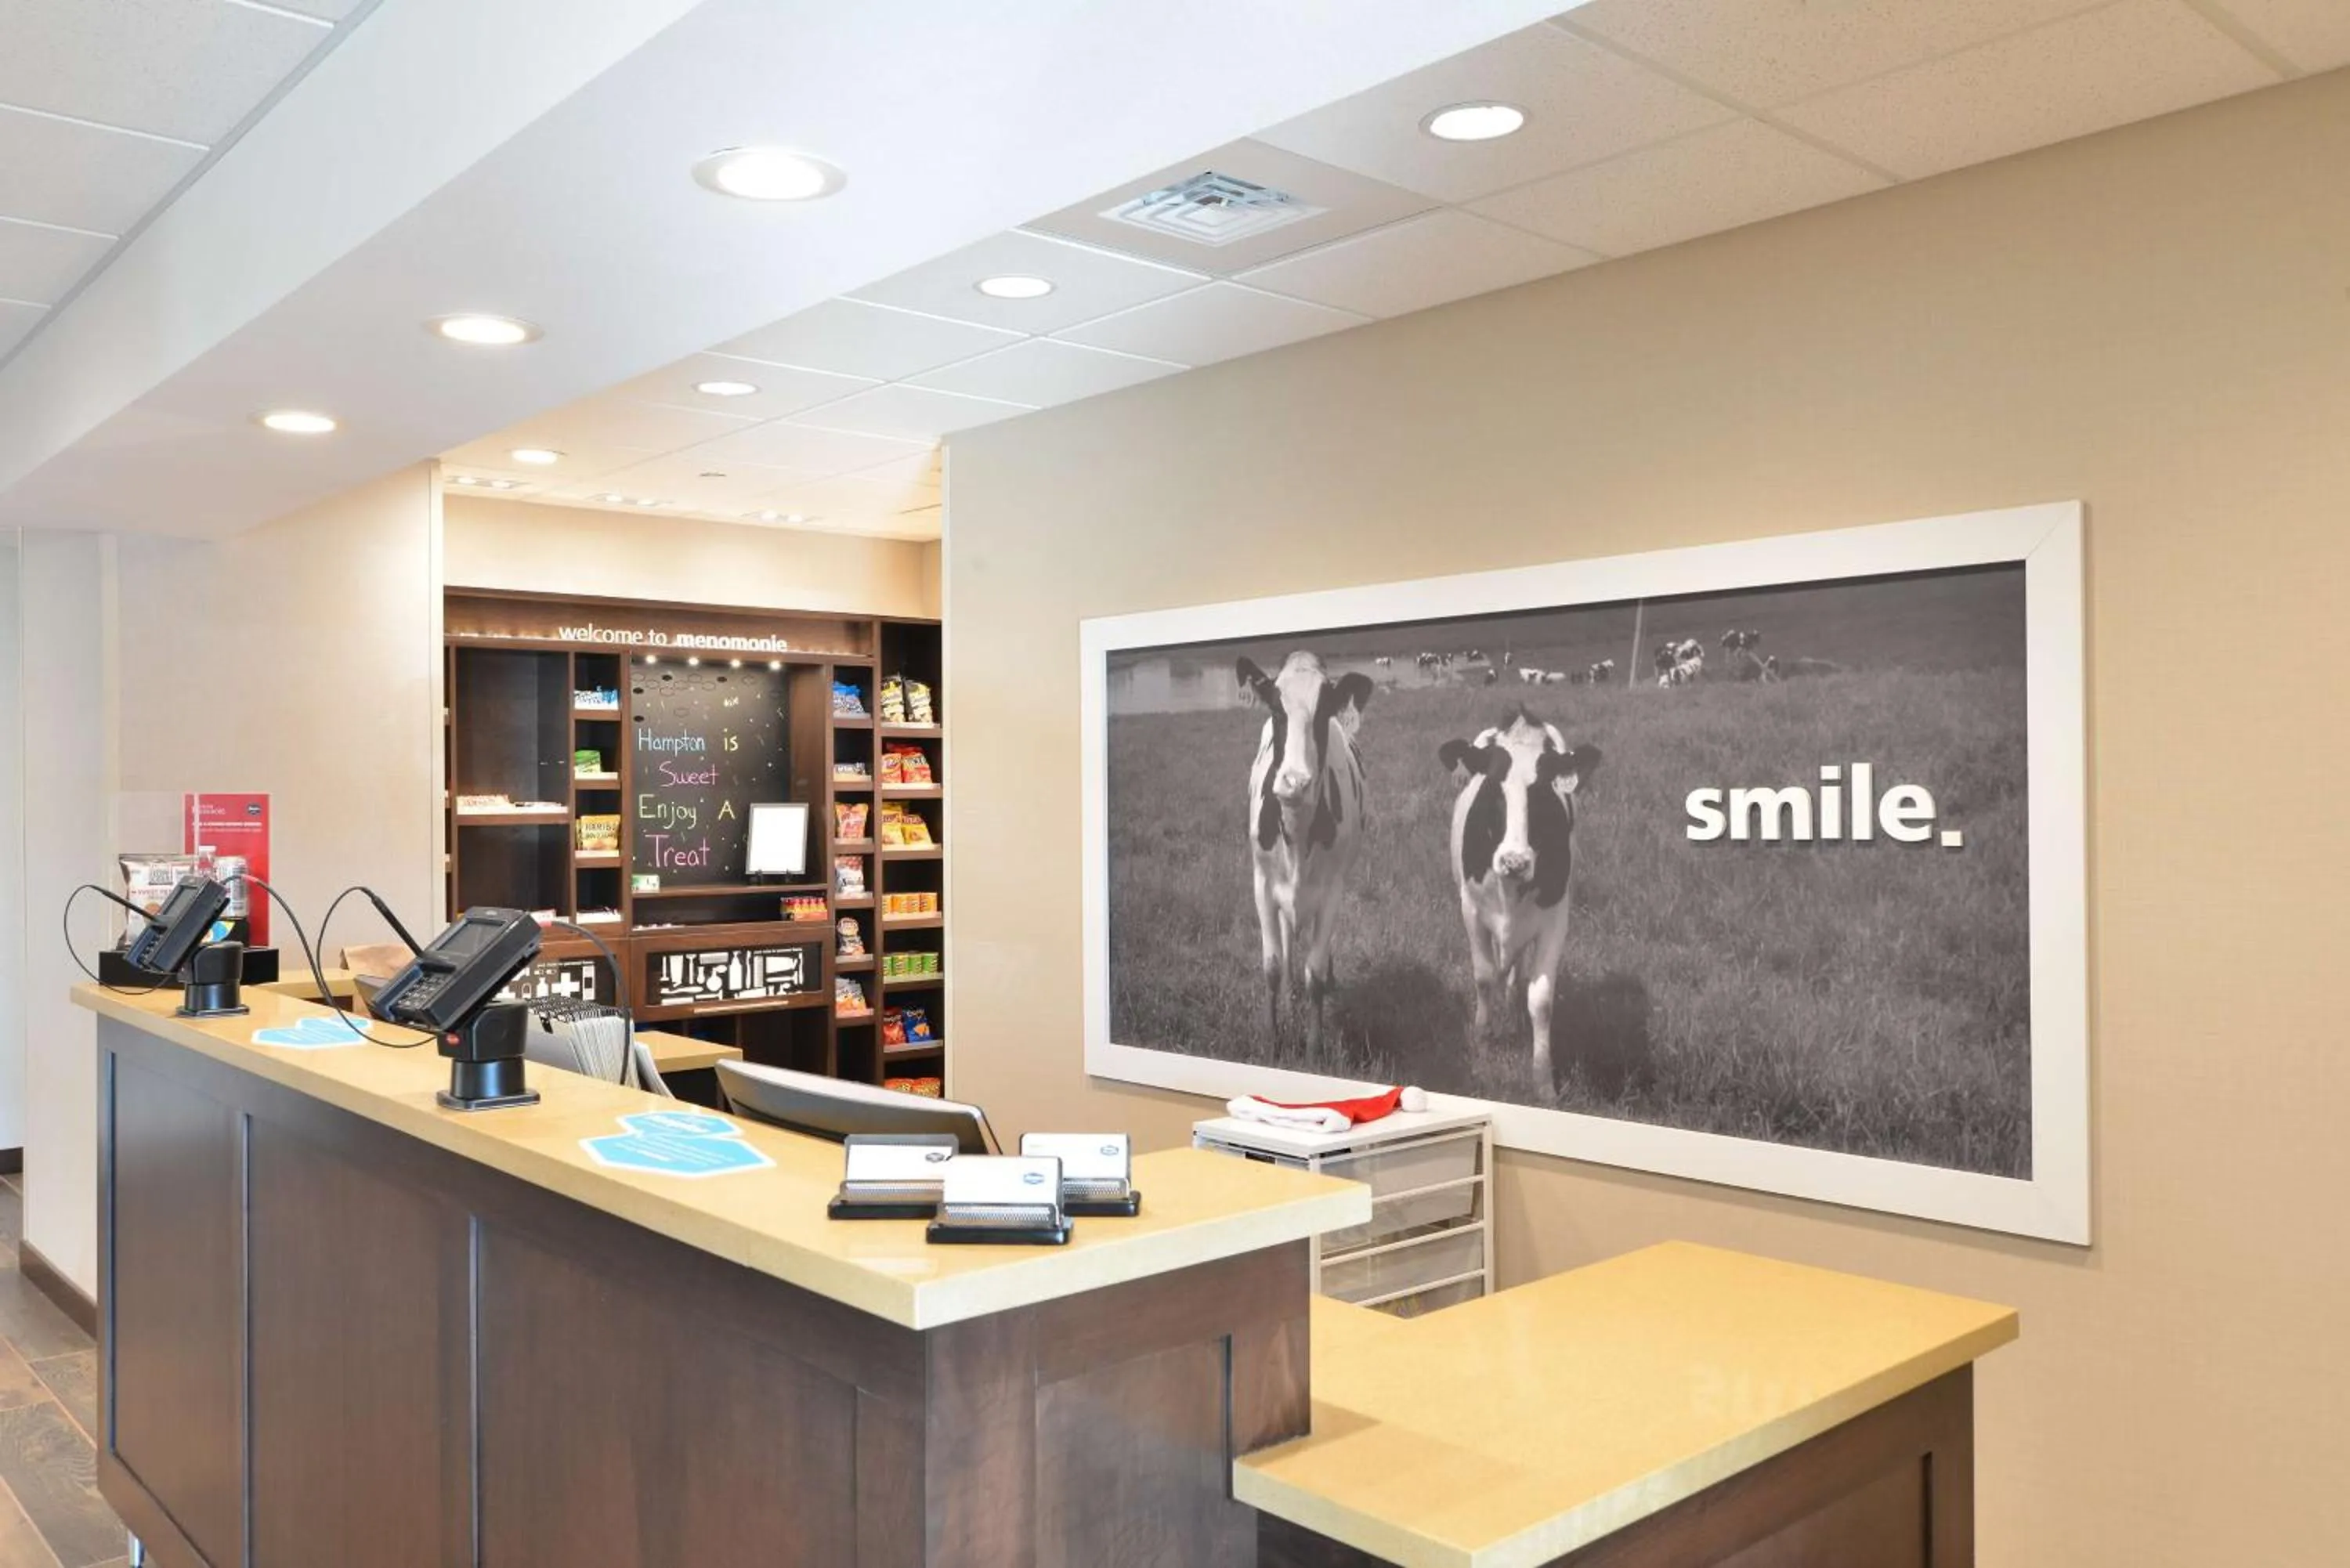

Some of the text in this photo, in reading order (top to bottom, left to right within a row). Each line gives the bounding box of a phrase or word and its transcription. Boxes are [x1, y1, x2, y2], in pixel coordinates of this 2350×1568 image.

[559, 623, 787, 652] welcome to menomonie
[638, 728, 739, 757] Hampton is
[659, 761, 720, 787] Sweet
[638, 793, 736, 829] Enjoy A
[1685, 763, 1963, 847] smile.
[645, 833, 710, 868] Treat
